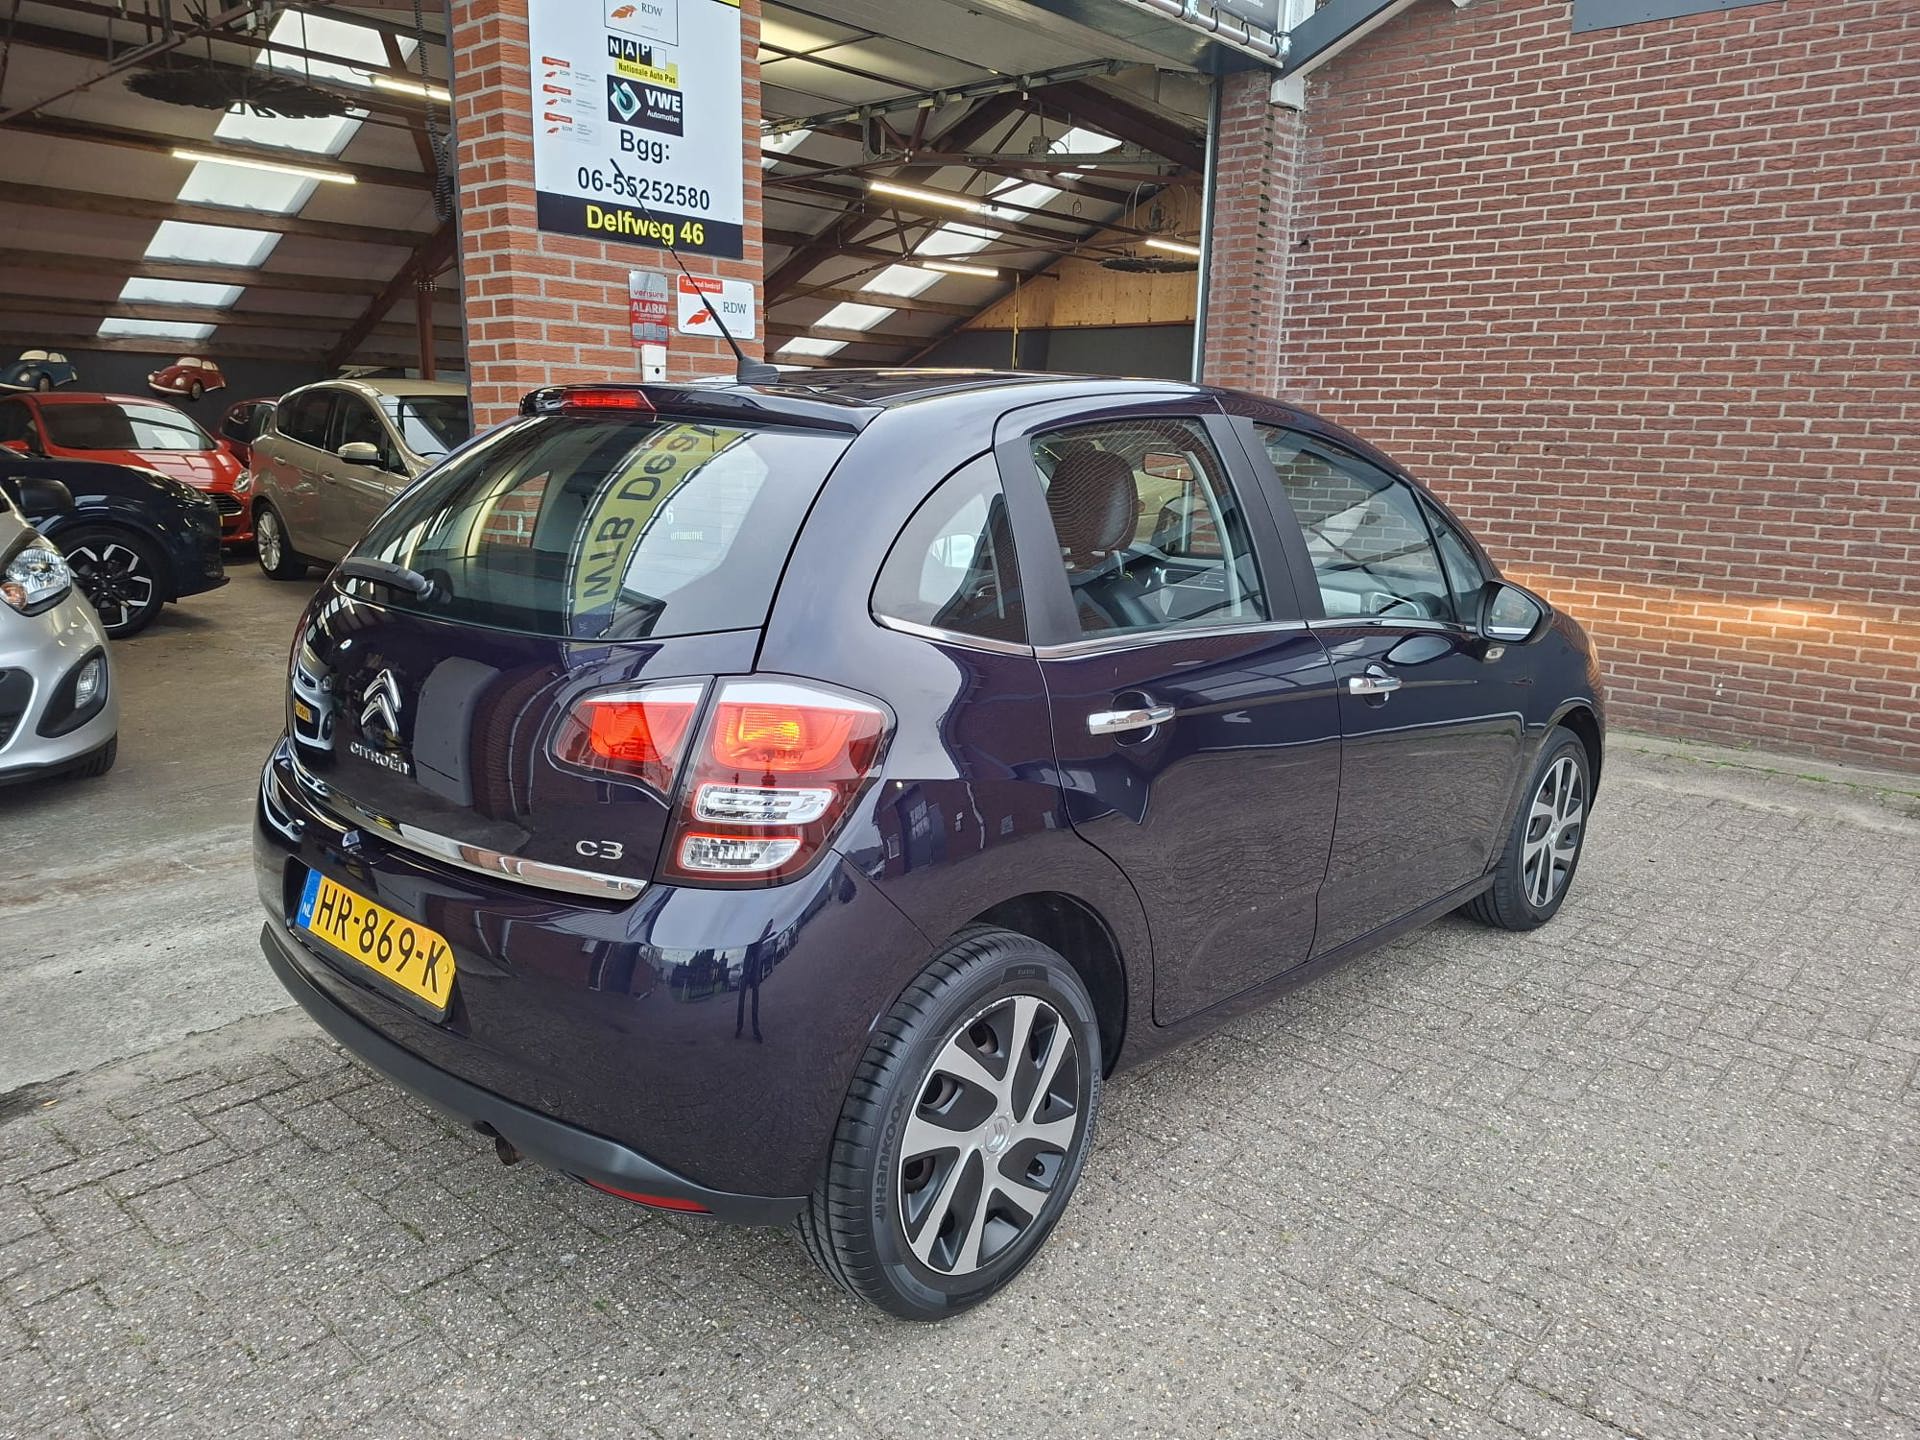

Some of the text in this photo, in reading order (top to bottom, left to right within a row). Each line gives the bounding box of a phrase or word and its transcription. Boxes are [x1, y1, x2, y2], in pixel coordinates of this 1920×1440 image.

[641, 2, 663, 17] RDW
[609, 38, 650, 57] NAP
[618, 62, 676, 84] Nationale Auto Pas
[644, 88, 681, 113] VWE
[646, 109, 680, 124] Automotive
[620, 128, 670, 164] Bgg:
[577, 166, 710, 210] 06-55252580
[586, 204, 705, 246] Delfweg 46
[632, 301, 667, 315] ALARM
[723, 301, 747, 315] RDW
[576, 840, 623, 860] C3
[301, 902, 312, 918] NL
[316, 884, 446, 994] HR-869-K
